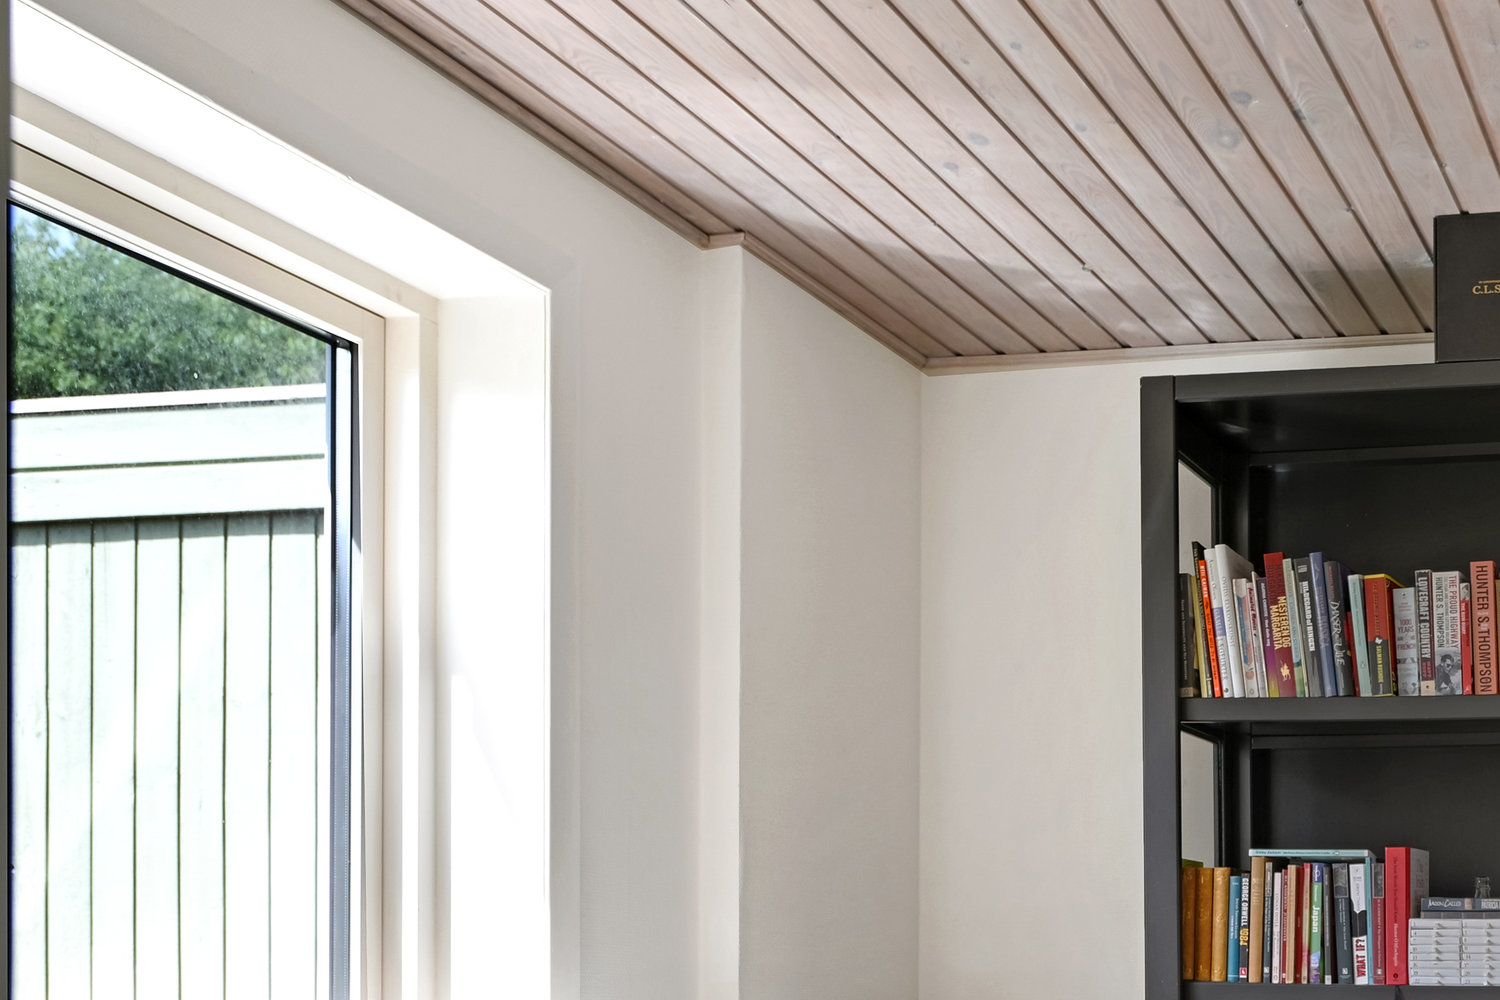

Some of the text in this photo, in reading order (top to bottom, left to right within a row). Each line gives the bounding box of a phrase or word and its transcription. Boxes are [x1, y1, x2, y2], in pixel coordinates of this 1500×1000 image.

[1435, 577, 1443, 603] HUNTER
[1448, 576, 1459, 649] THE PROUD HIGHWAY
[1270, 605, 1282, 650] MARGARITA
[1277, 596, 1289, 636] MESTEREN
[1283, 637, 1291, 648] OG
[1418, 577, 1431, 658] LOVECRAFT COUNTRY
[1436, 613, 1444, 648] THOMPSON
[1475, 566, 1492, 692] HUNTER S. THOMPSON
[1240, 878, 1249, 946] GEORGE ORWELL 1984
[1311, 905, 1320, 932] Japan
[1356, 939, 1366, 977] WHAT IF?
